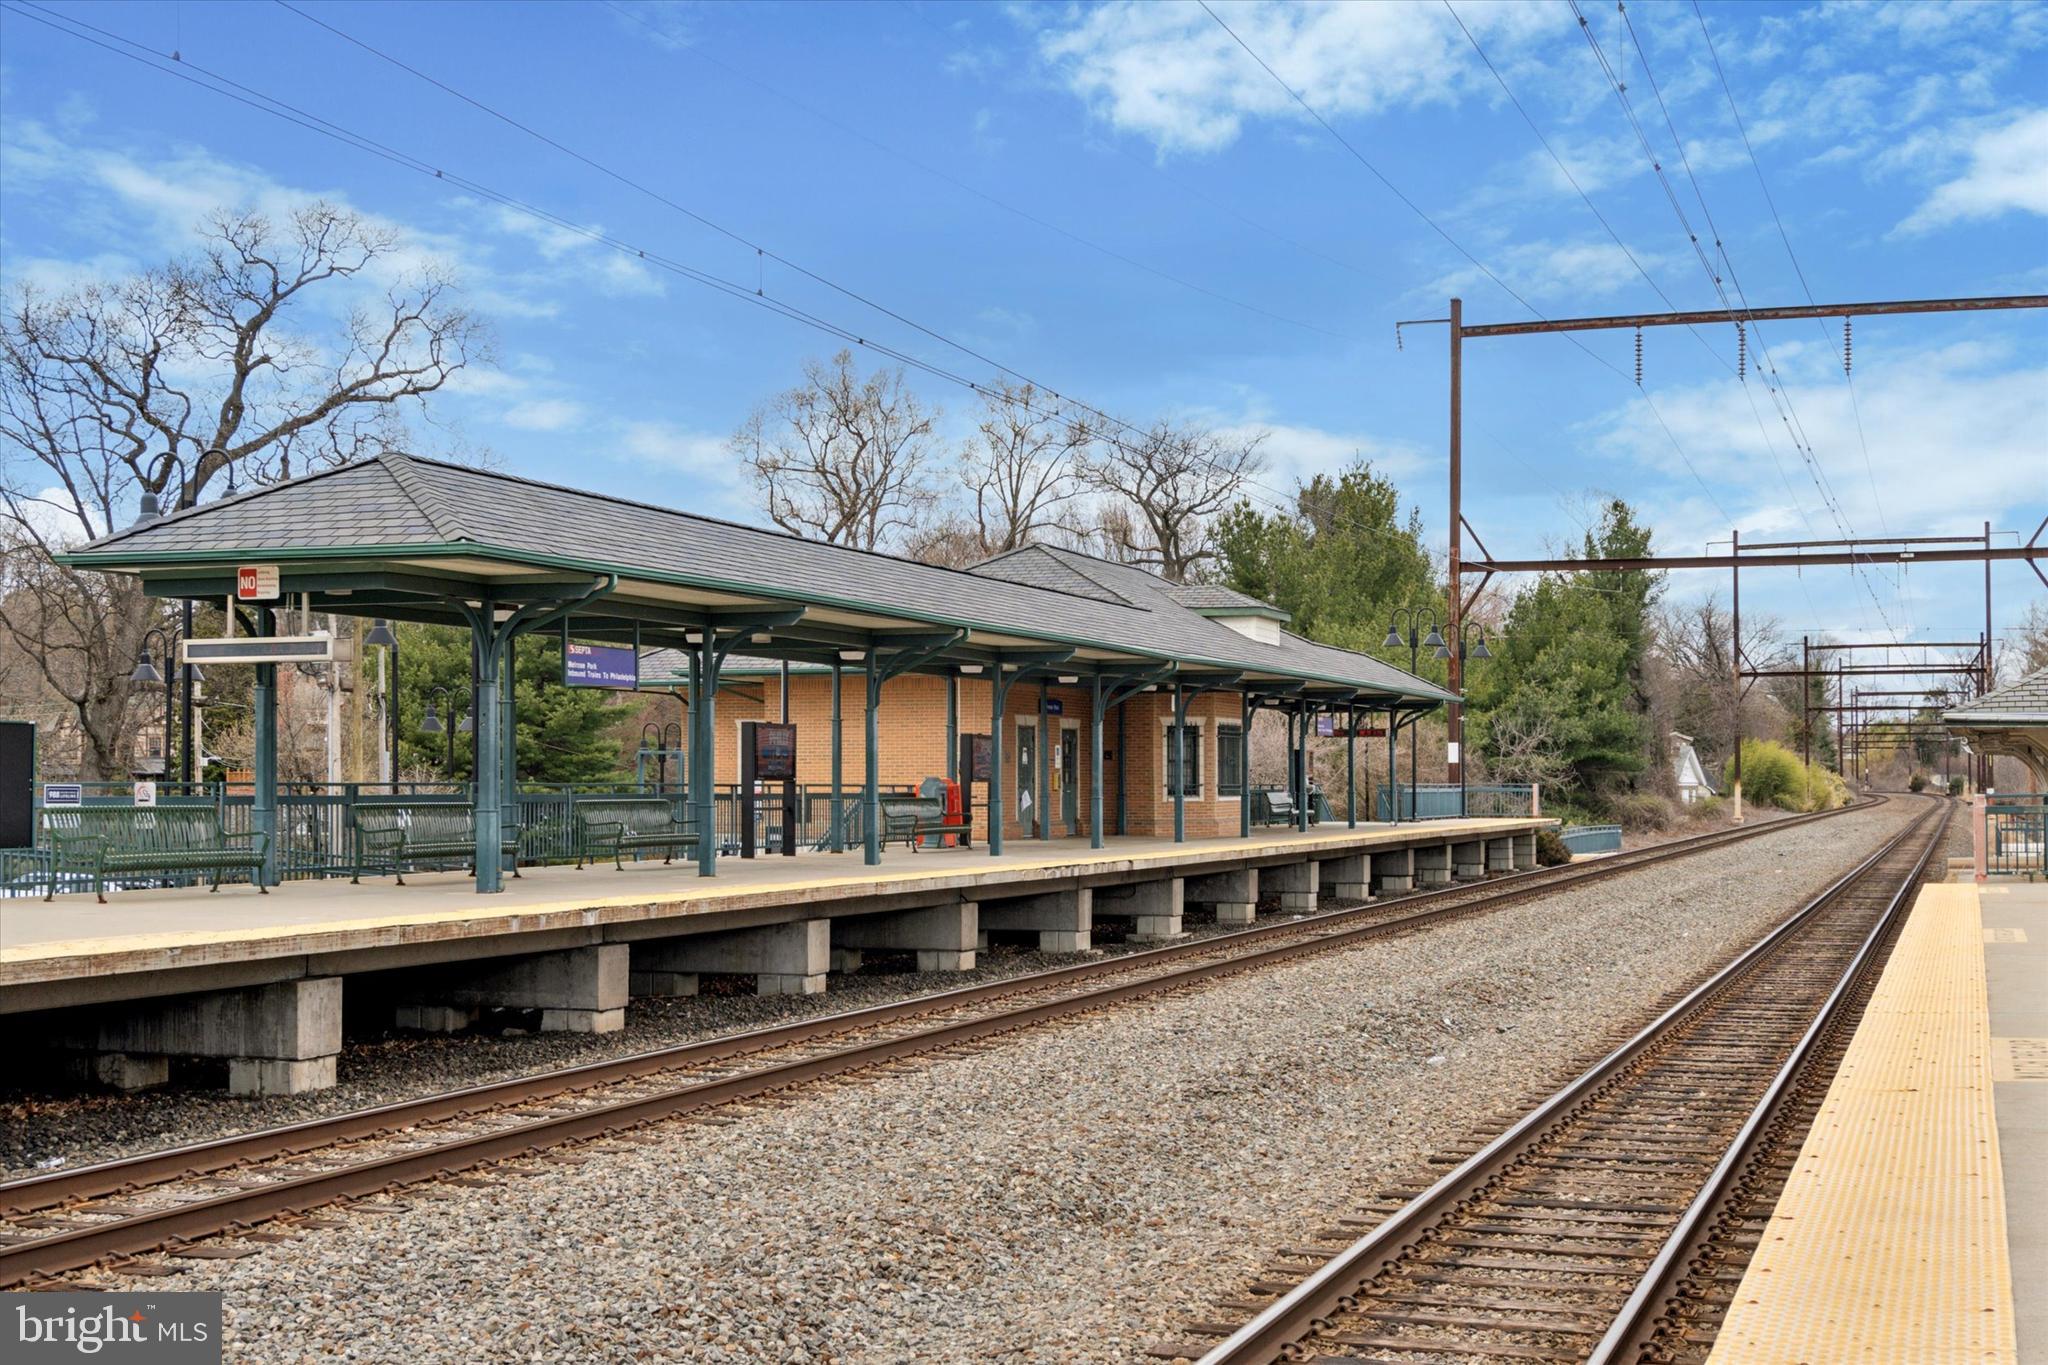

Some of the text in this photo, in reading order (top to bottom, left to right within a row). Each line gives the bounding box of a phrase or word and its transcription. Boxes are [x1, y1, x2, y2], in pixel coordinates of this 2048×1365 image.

[240, 576, 256, 590] NO
[575, 646, 592, 654] SEPTA
[588, 670, 602, 679] Trains
